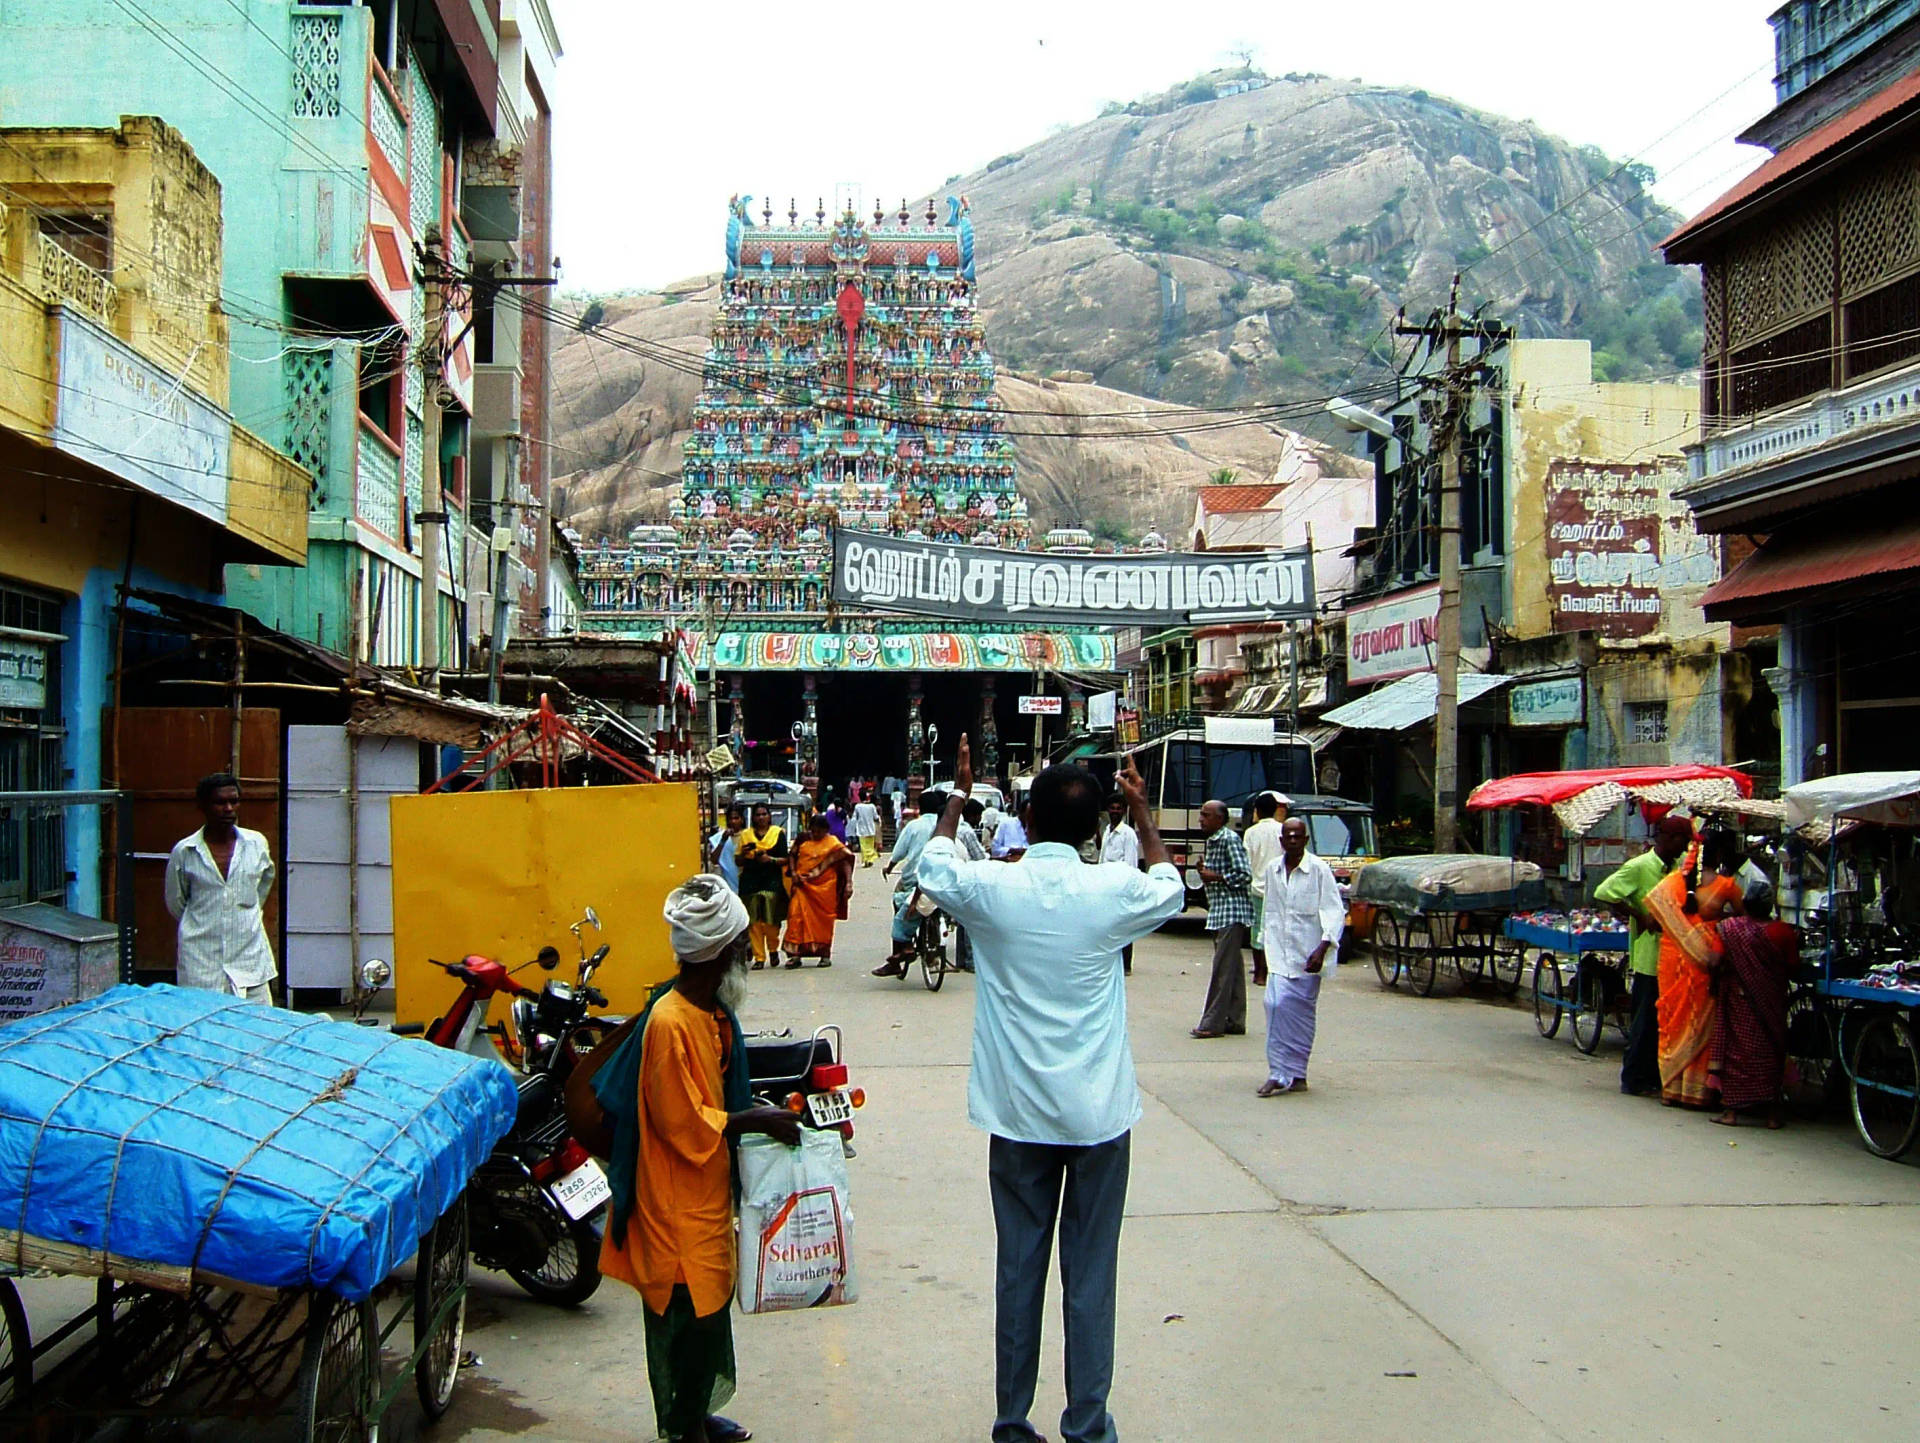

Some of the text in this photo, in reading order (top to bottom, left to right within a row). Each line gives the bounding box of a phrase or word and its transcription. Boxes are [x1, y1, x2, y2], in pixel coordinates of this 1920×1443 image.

[844, 541, 961, 603] ஹோட்டல்
[1352, 623, 1404, 663] சரவண
[574, 1045, 594, 1055] SUZ
[769, 1235, 839, 1263] Selvaraj
[785, 1265, 831, 1282] Brothers
